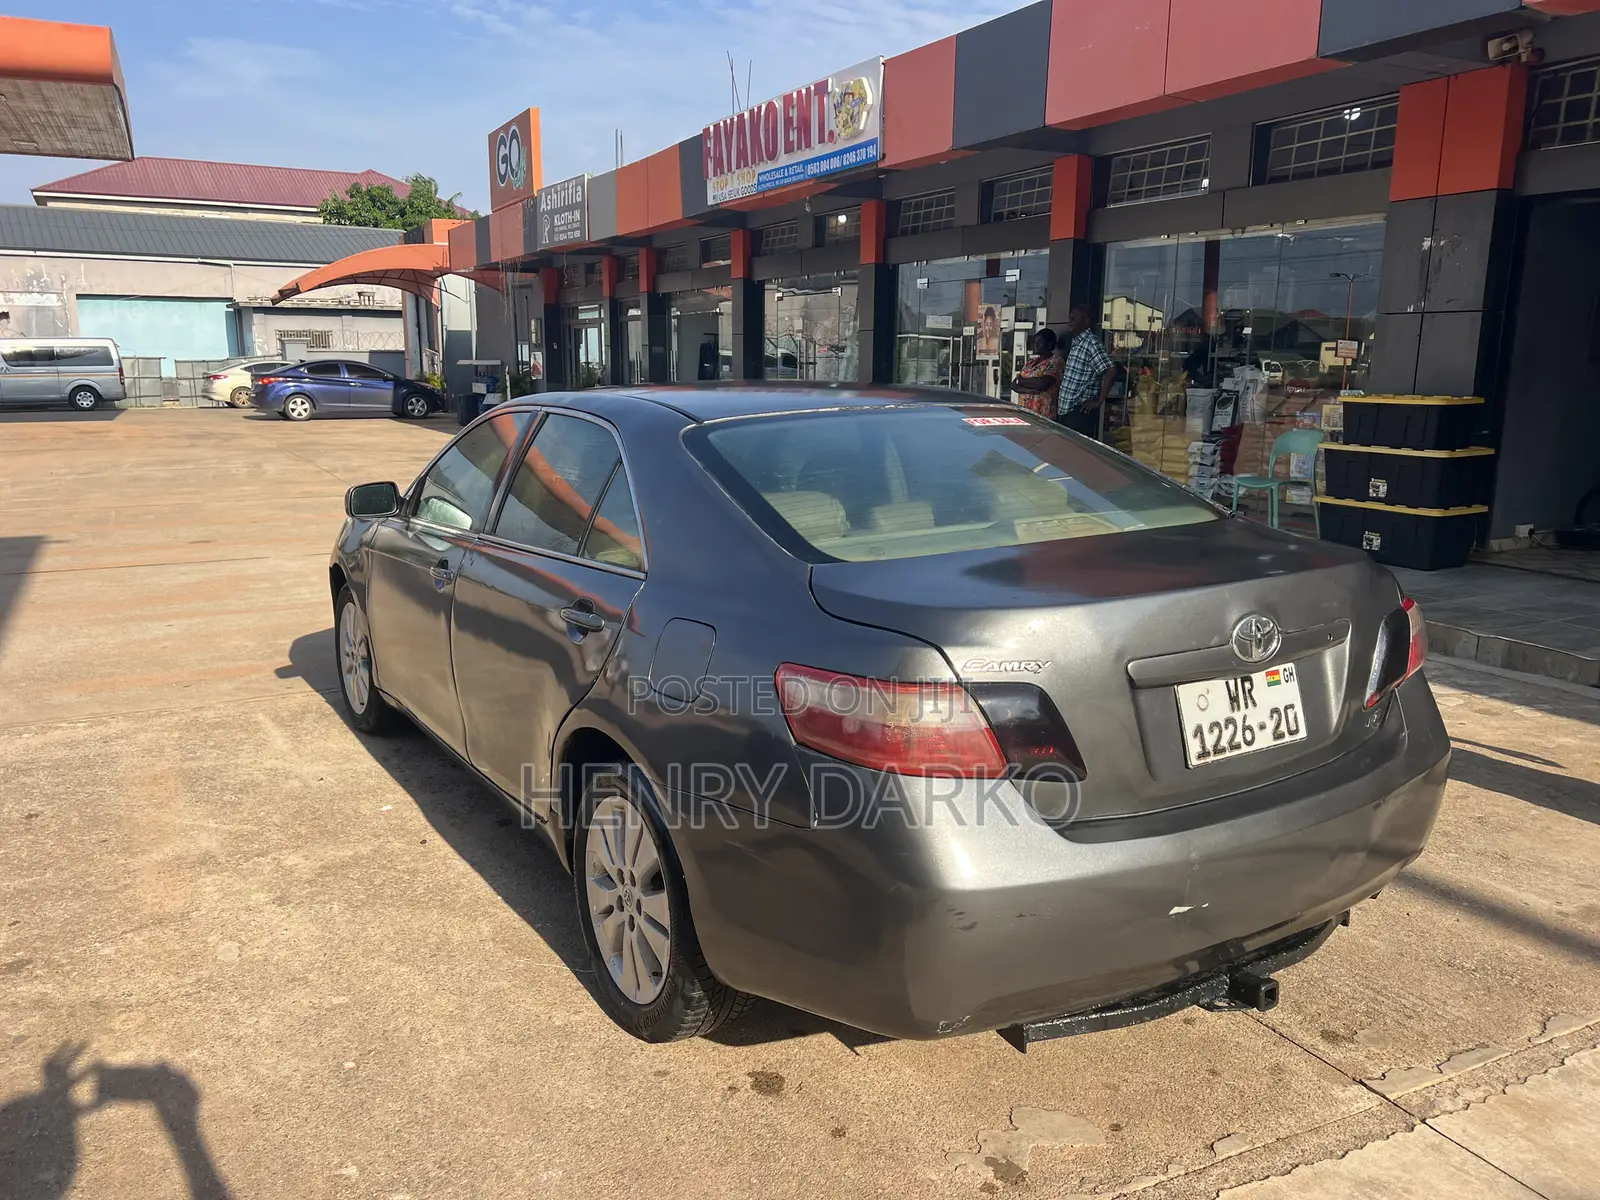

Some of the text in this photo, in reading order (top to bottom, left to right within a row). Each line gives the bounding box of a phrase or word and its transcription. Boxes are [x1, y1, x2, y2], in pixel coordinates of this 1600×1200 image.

[702, 77, 836, 180] FAYAKO ENT.
[496, 123, 522, 187] GO
[712, 177, 728, 193] STOP
[737, 170, 756, 186] SHOP
[758, 169, 784, 182] WHOLESALE
[789, 163, 804, 176] RETAIL
[540, 179, 582, 212] Ashirifia
[741, 183, 757, 196] GOODS
[553, 208, 581, 226] KLOTH-IN
[962, 658, 1053, 674] CAMRY
[1282, 666, 1295, 684] GH
[1225, 675, 1258, 713] WR
[1192, 703, 1300, 761] 1226-20
